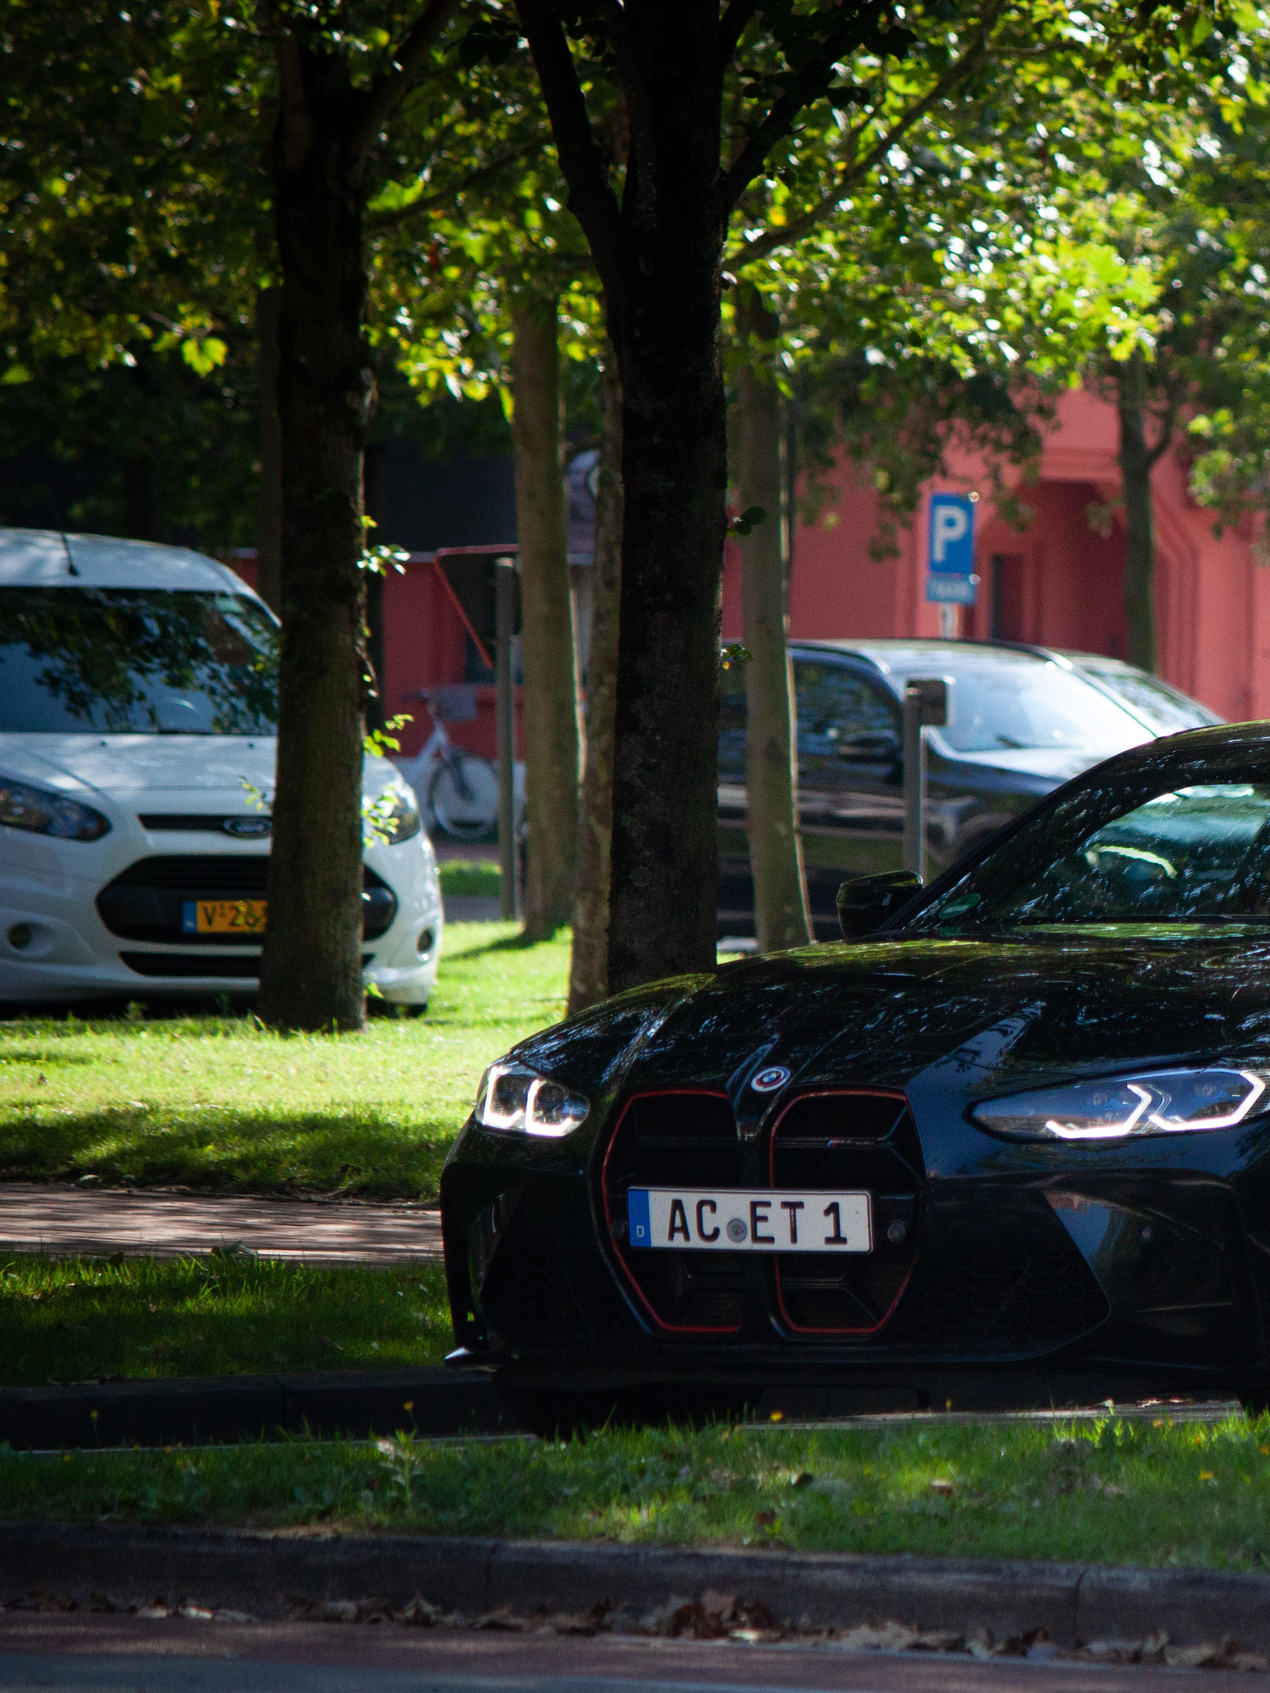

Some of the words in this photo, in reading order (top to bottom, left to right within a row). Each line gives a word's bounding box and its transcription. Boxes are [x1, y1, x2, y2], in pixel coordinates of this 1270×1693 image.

[933, 504, 968, 563] P
[636, 1225, 645, 1238] D
[667, 1198, 720, 1243] AC
[750, 1200, 805, 1245] ET
[823, 1201, 848, 1245] 1
